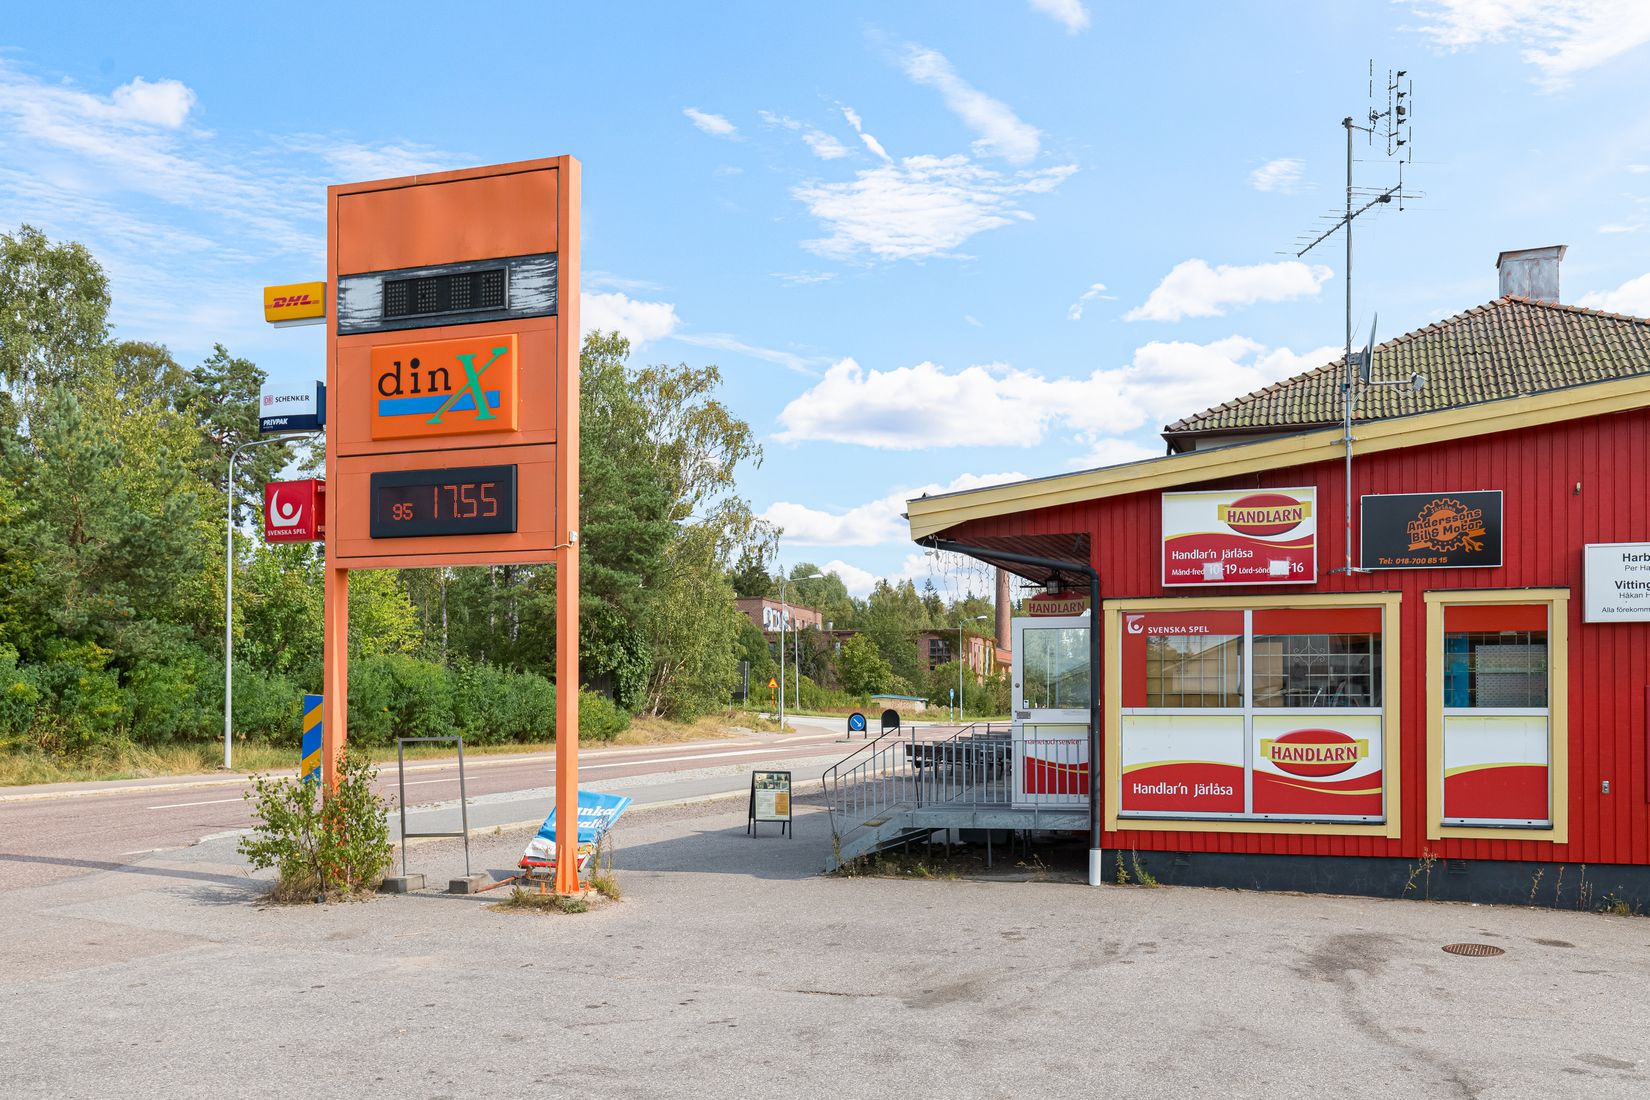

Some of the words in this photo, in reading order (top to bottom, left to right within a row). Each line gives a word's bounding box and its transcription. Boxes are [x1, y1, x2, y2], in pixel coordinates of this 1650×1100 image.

[272, 294, 312, 308] DHL
[275, 395, 310, 403] SCHENKER
[263, 418, 288, 426] PRIVPAK
[392, 503, 413, 520] 95
[1407, 508, 1483, 533] Anderssons
[1411, 529, 1431, 543] Bil
[1431, 528, 1440, 538] &
[1443, 520, 1483, 535] Motor
[1171, 549, 1217, 560] Handlar'n
[1221, 549, 1254, 560] Järlåsa
[1379, 557, 1393, 565] Tel:
[1147, 626, 1187, 634] SVENSKA
[1188, 625, 1210, 633] SPEL
[1271, 745, 1358, 761] HANDLAR'N
[1133, 782, 1188, 795] Handlar'n
[1193, 783, 1233, 798] Järlåsa
